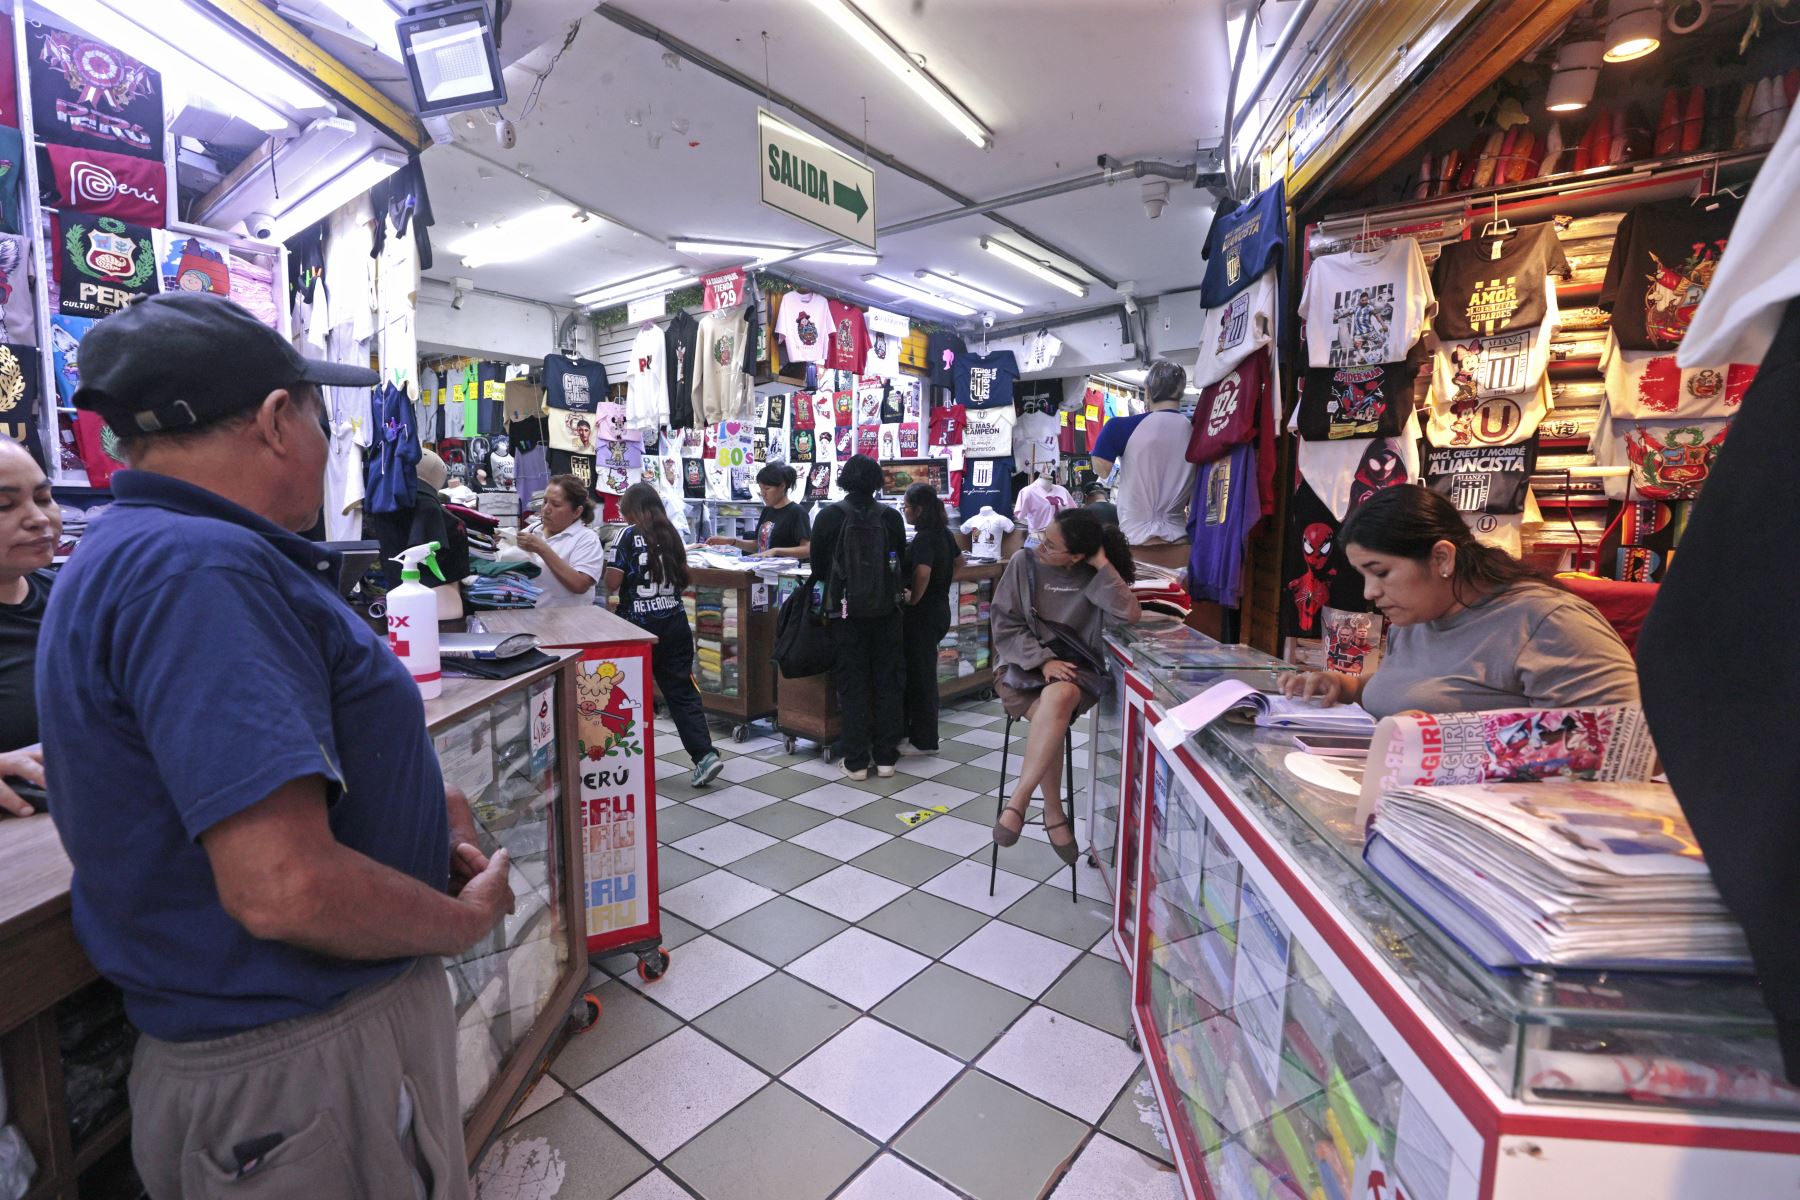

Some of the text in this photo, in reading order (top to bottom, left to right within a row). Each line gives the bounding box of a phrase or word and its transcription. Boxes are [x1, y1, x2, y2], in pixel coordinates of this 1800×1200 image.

[768, 143, 830, 206] SALIDA
[80, 282, 136, 309] PER
[714, 281, 734, 293] TIENDA
[1469, 287, 1517, 306] AMOR
[1334, 367, 1384, 383] SPIDER-MAN
[1210, 388, 1239, 420] 1924
[1481, 406, 1511, 438] U
[719, 447, 754, 468] 80's
[1428, 446, 1526, 460] NACÍ, CRECÍ Y MORIRÉ
[1428, 457, 1525, 475] ALIANCISTA
[1481, 519, 1492, 530] U
[580, 765, 629, 790] ERÚ
